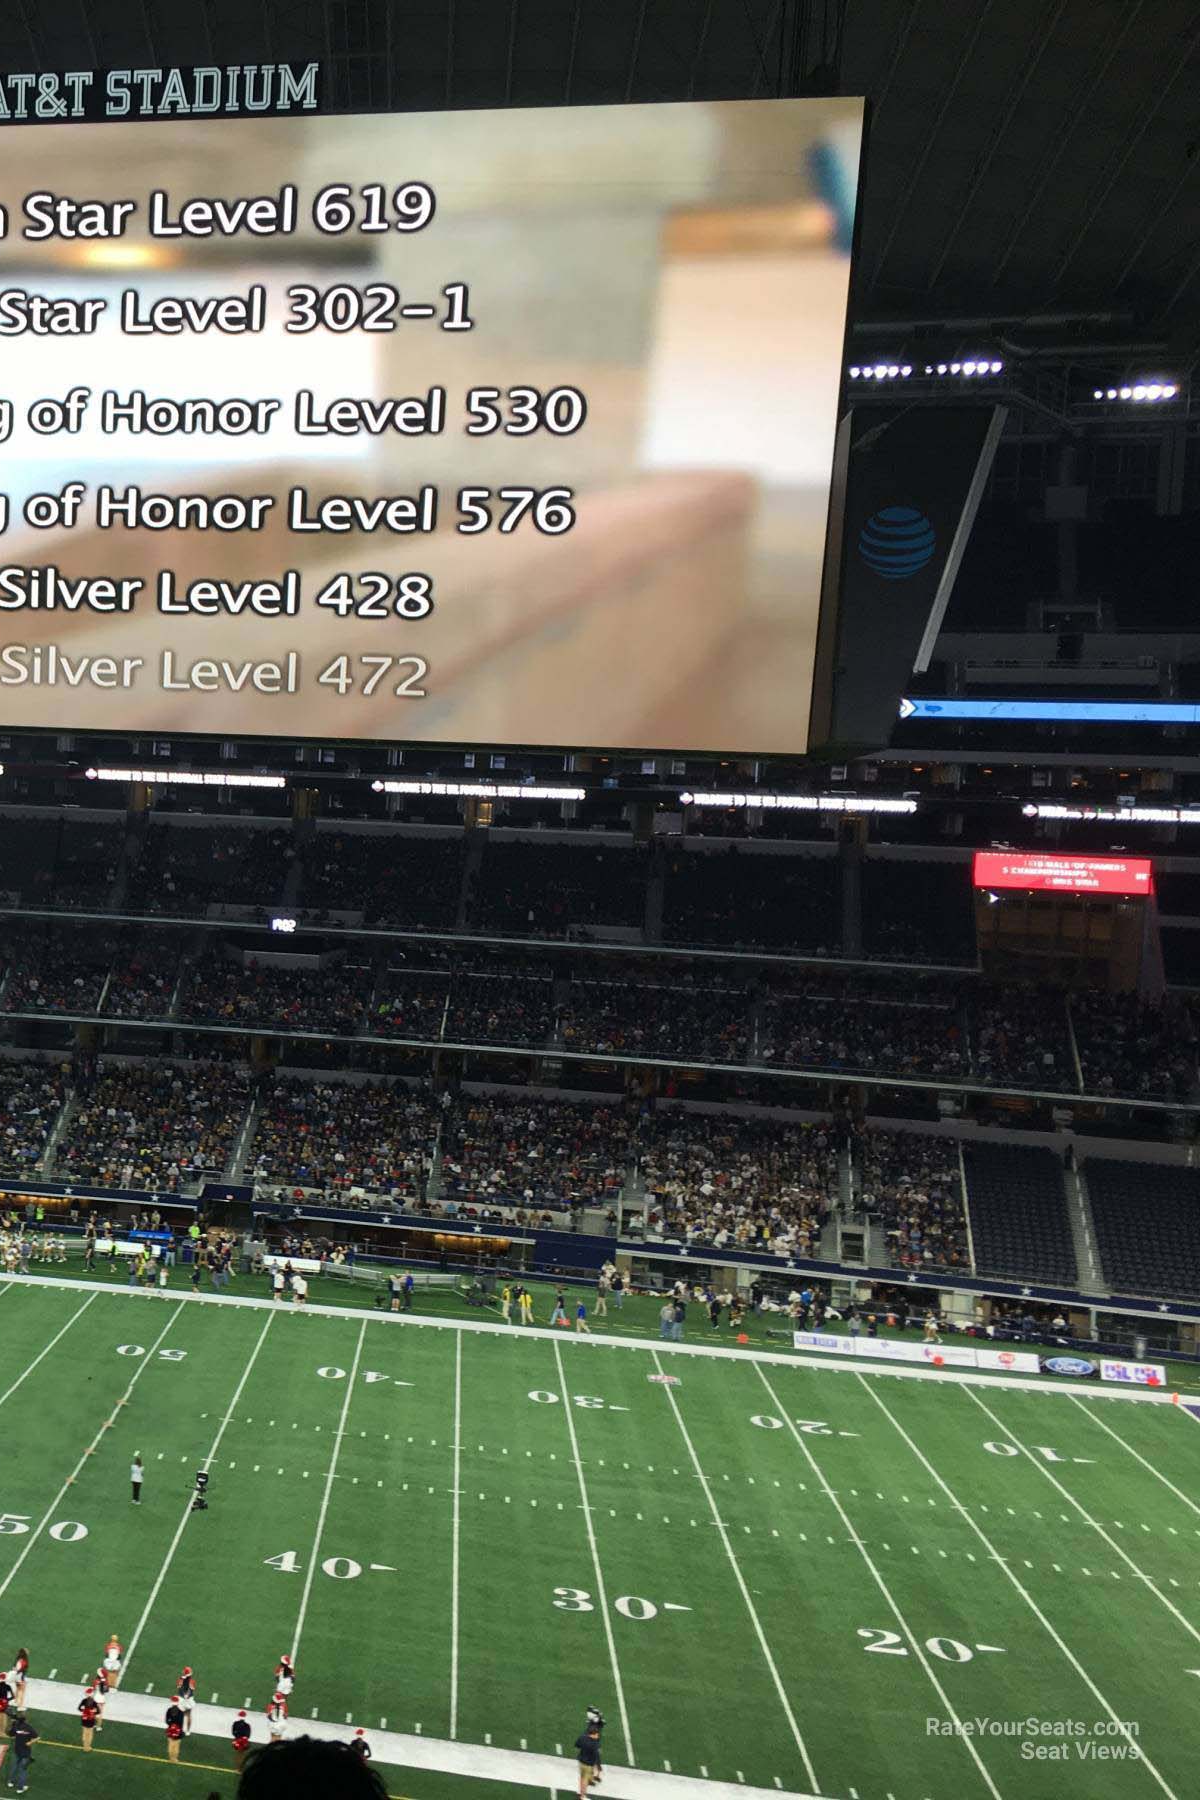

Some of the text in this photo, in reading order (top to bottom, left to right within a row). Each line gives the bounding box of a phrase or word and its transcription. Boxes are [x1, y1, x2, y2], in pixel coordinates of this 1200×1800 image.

[105, 62, 320, 116] STADIUM
[23, 193, 135, 238] Star
[152, 186, 295, 235] Level
[315, 184, 434, 232] 619
[125, 287, 263, 333] Level
[286, 285, 473, 332] 302-1
[28, 387, 91, 433] of
[103, 391, 279, 434] Honor
[296, 389, 443, 434] Level
[465, 388, 584, 434] 530
[25, 483, 85, 528] of
[98, 487, 273, 529] Honor
[291, 488, 435, 531] Level
[457, 489, 574, 533] 576
[159, 571, 298, 614] Level
[317, 574, 432, 618] 428
[0, 645, 143, 688] Silver
[162, 650, 297, 693] Level
[318, 654, 428, 697] 472
[263, 1550, 363, 1579] 40
[552, 1587, 658, 1620] 30
[856, 1628, 974, 1662] 20
